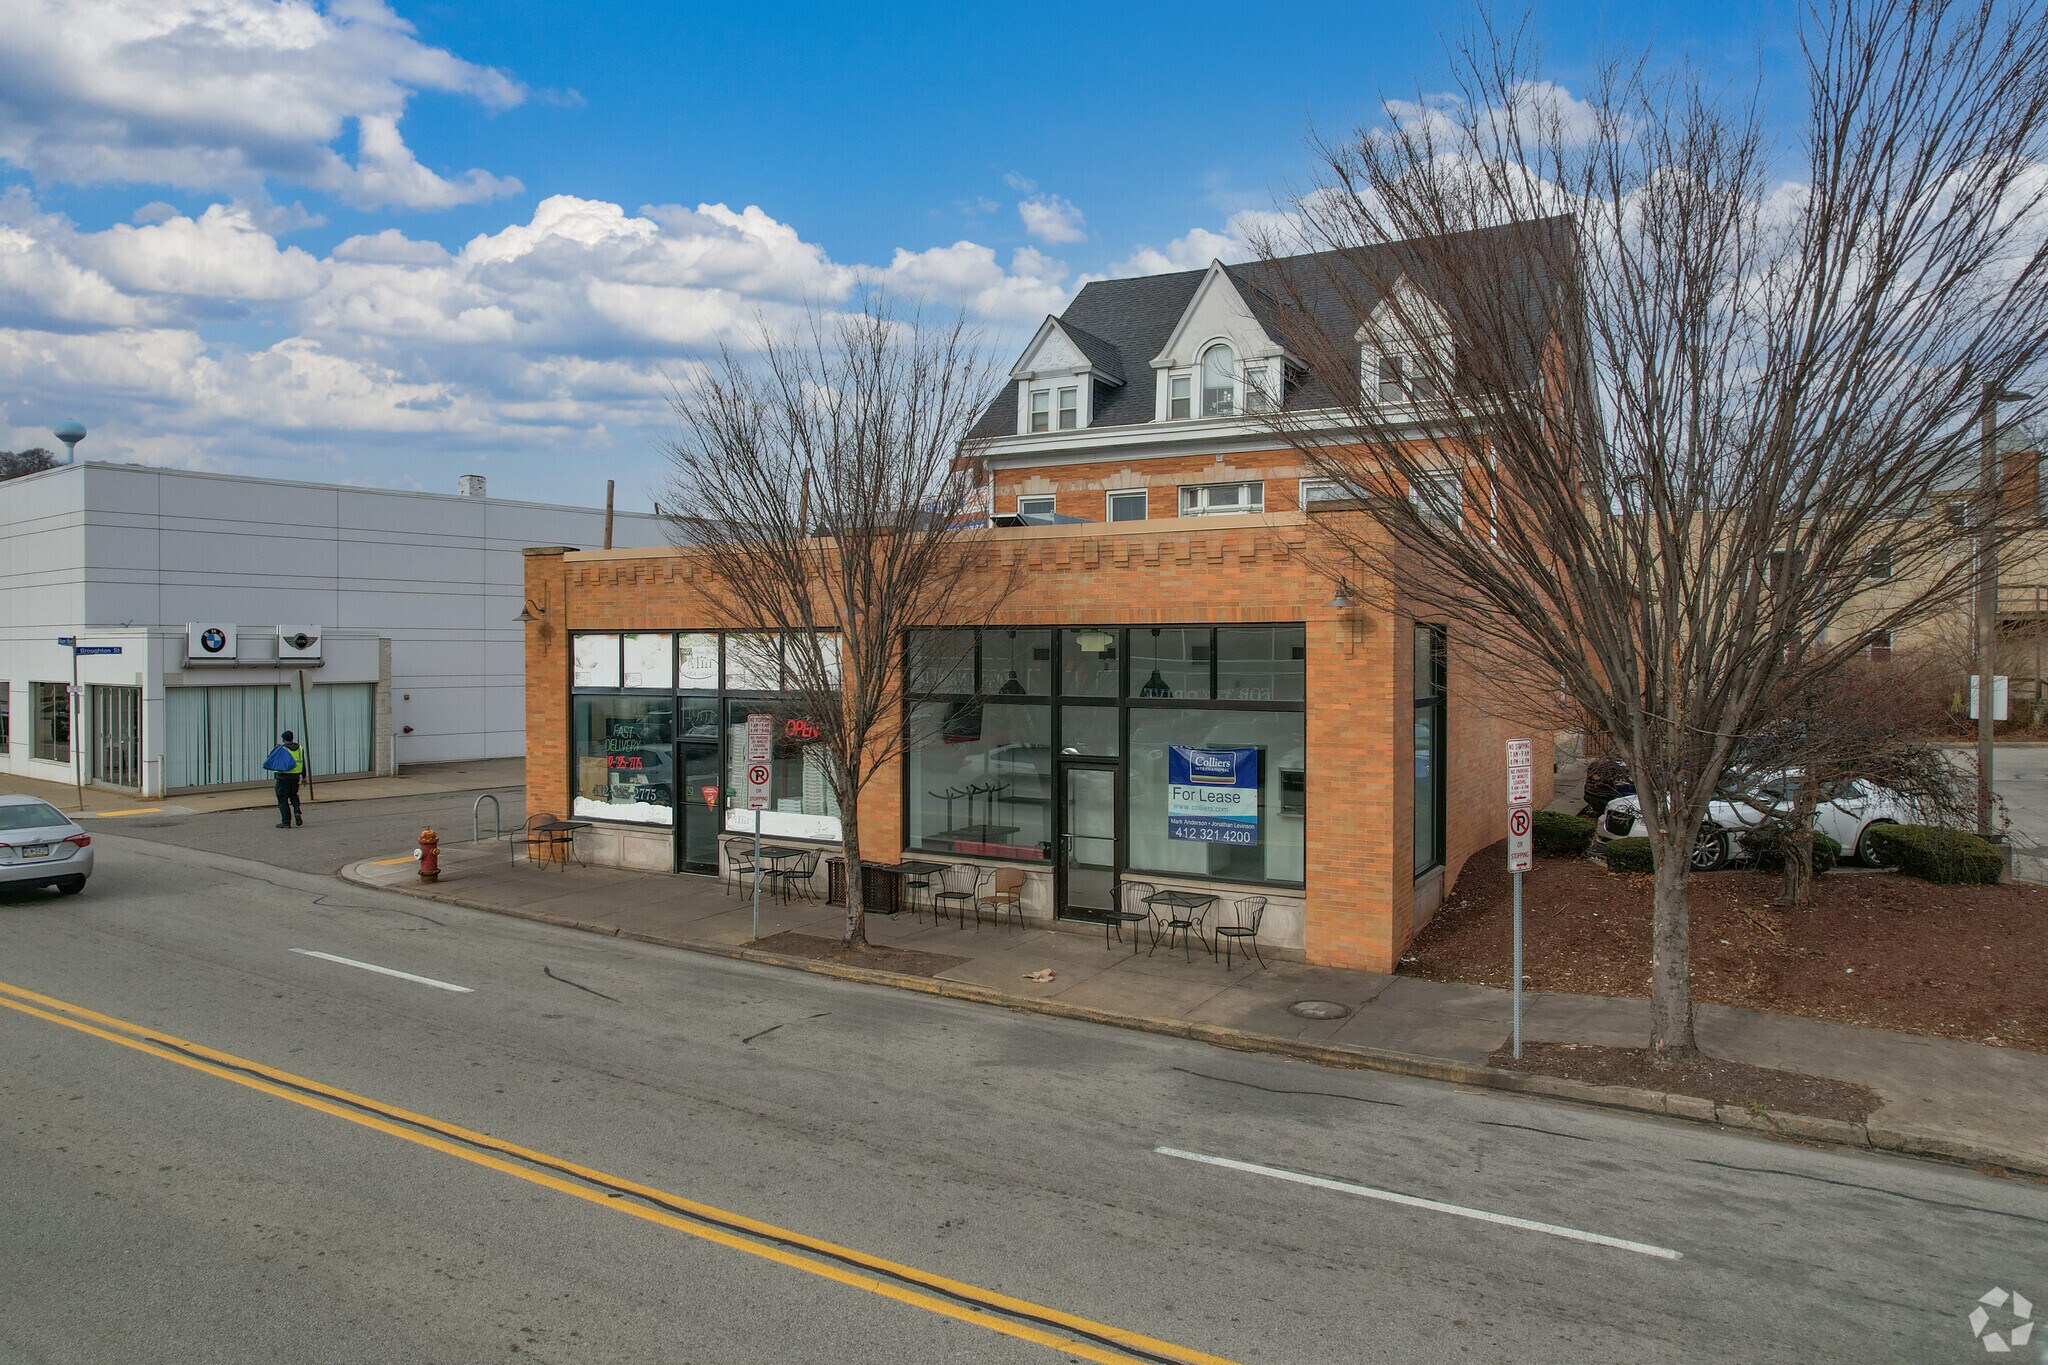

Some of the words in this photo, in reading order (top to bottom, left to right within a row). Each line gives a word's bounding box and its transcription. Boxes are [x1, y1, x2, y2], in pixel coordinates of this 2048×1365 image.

[613, 724, 634, 739] FAST
[785, 719, 820, 738] OPEN
[606, 738, 641, 752] DELIVERY
[1515, 742, 1529, 750] STOPPING
[1195, 756, 1230, 768] Colliers
[1173, 787, 1195, 801] For
[1200, 789, 1241, 803] Lease
[1211, 820, 1233, 828] Jonathan
[1175, 827, 1196, 839] 412
[1200, 829, 1219, 840] 321
[1223, 830, 1251, 843] 4200
[1511, 851, 1529, 860] STOPPING
